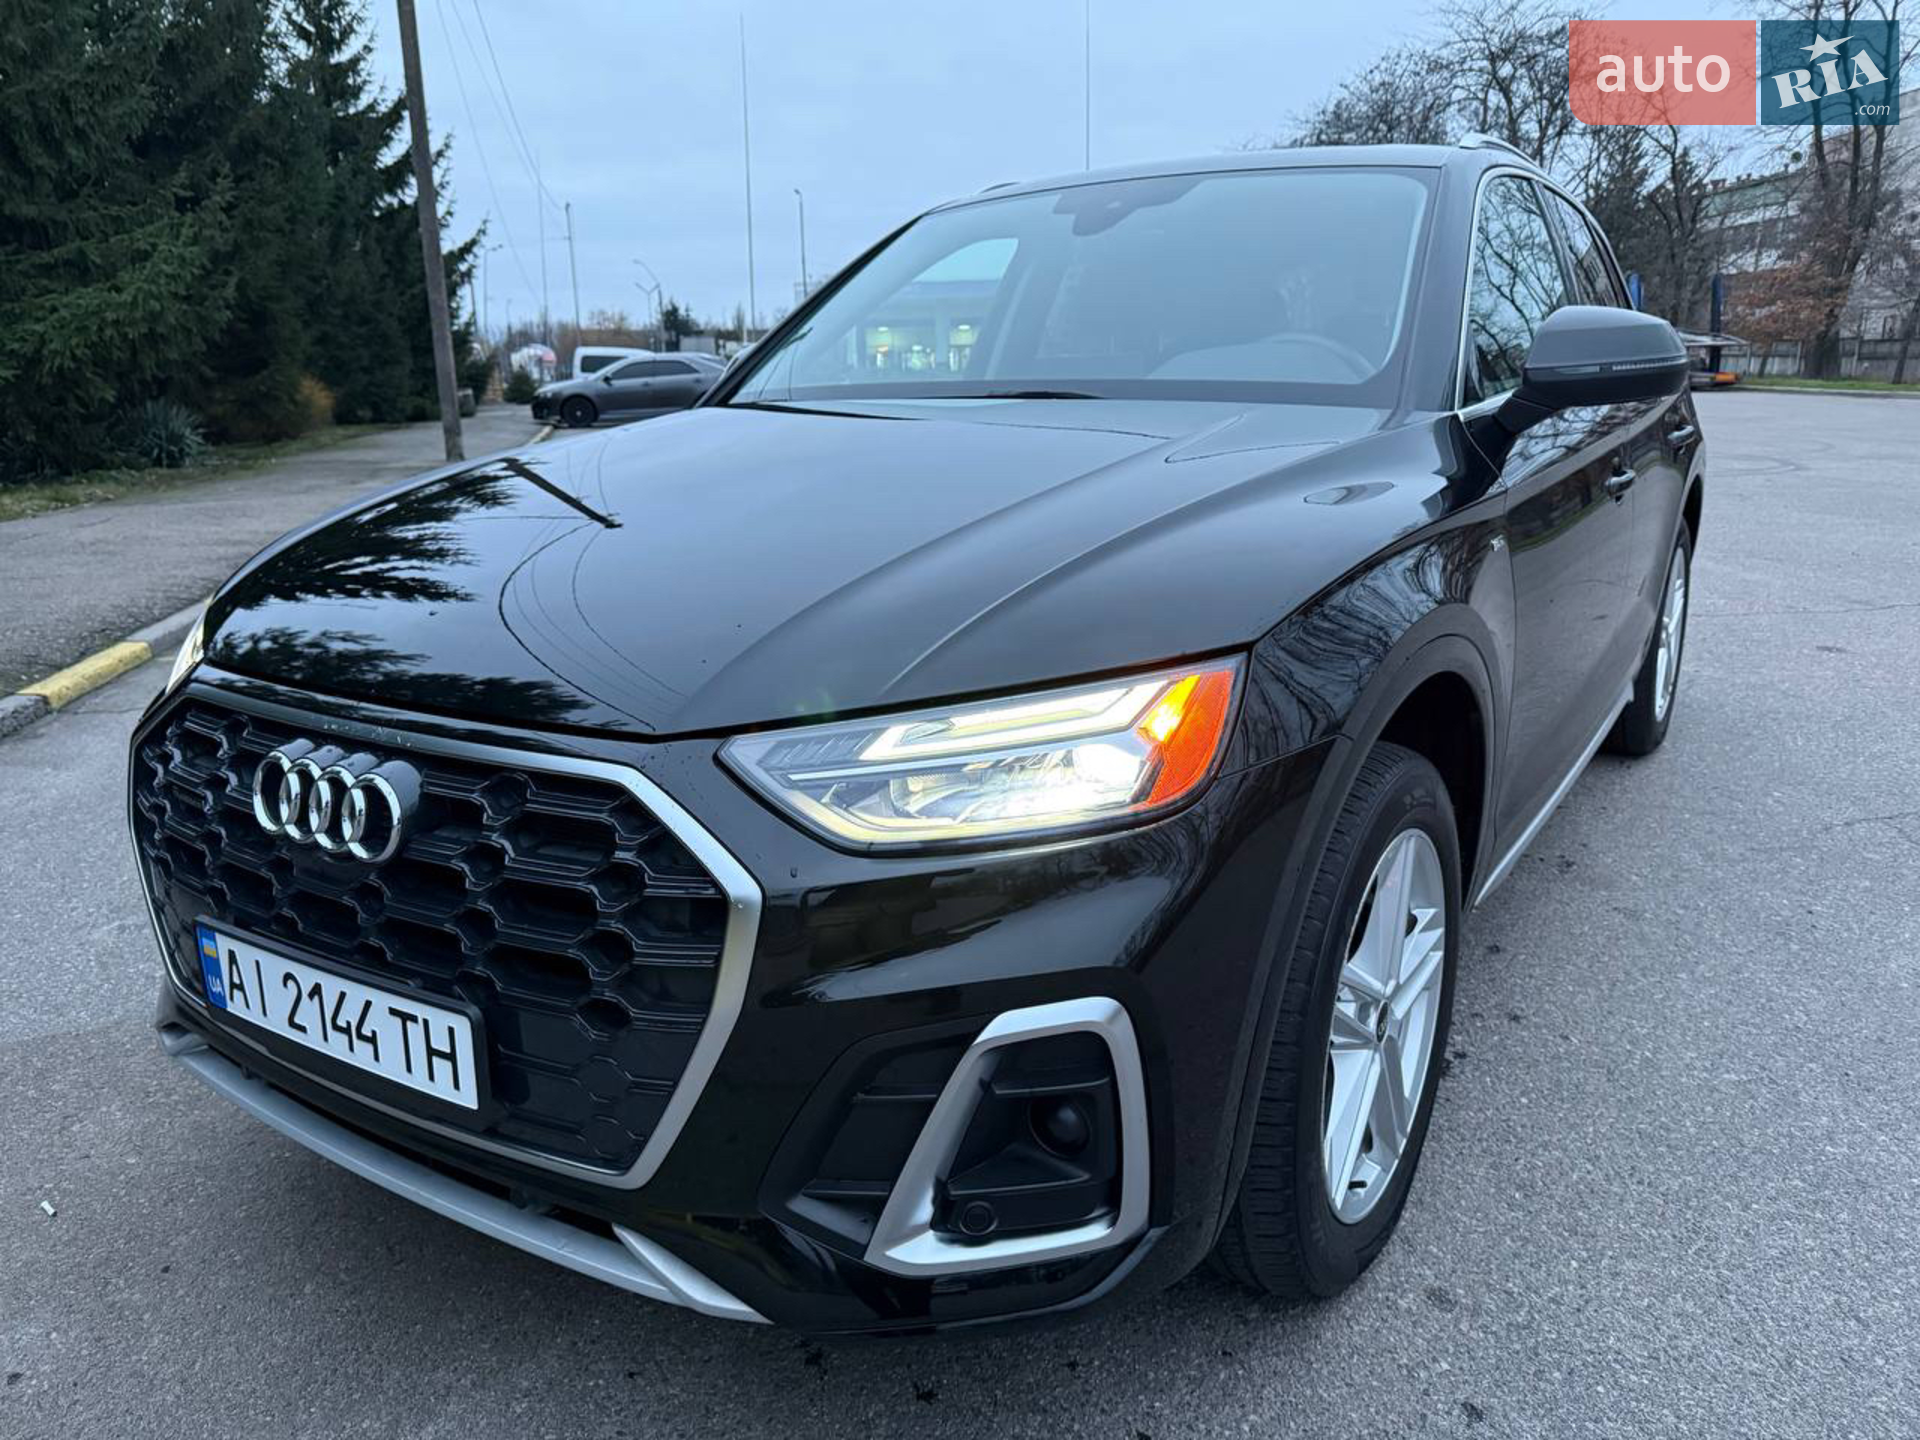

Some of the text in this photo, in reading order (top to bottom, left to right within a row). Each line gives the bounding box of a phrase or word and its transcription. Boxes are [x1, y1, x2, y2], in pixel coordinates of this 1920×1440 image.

[208, 974, 225, 997] UA
[228, 948, 460, 1092] AI 2144 TH
